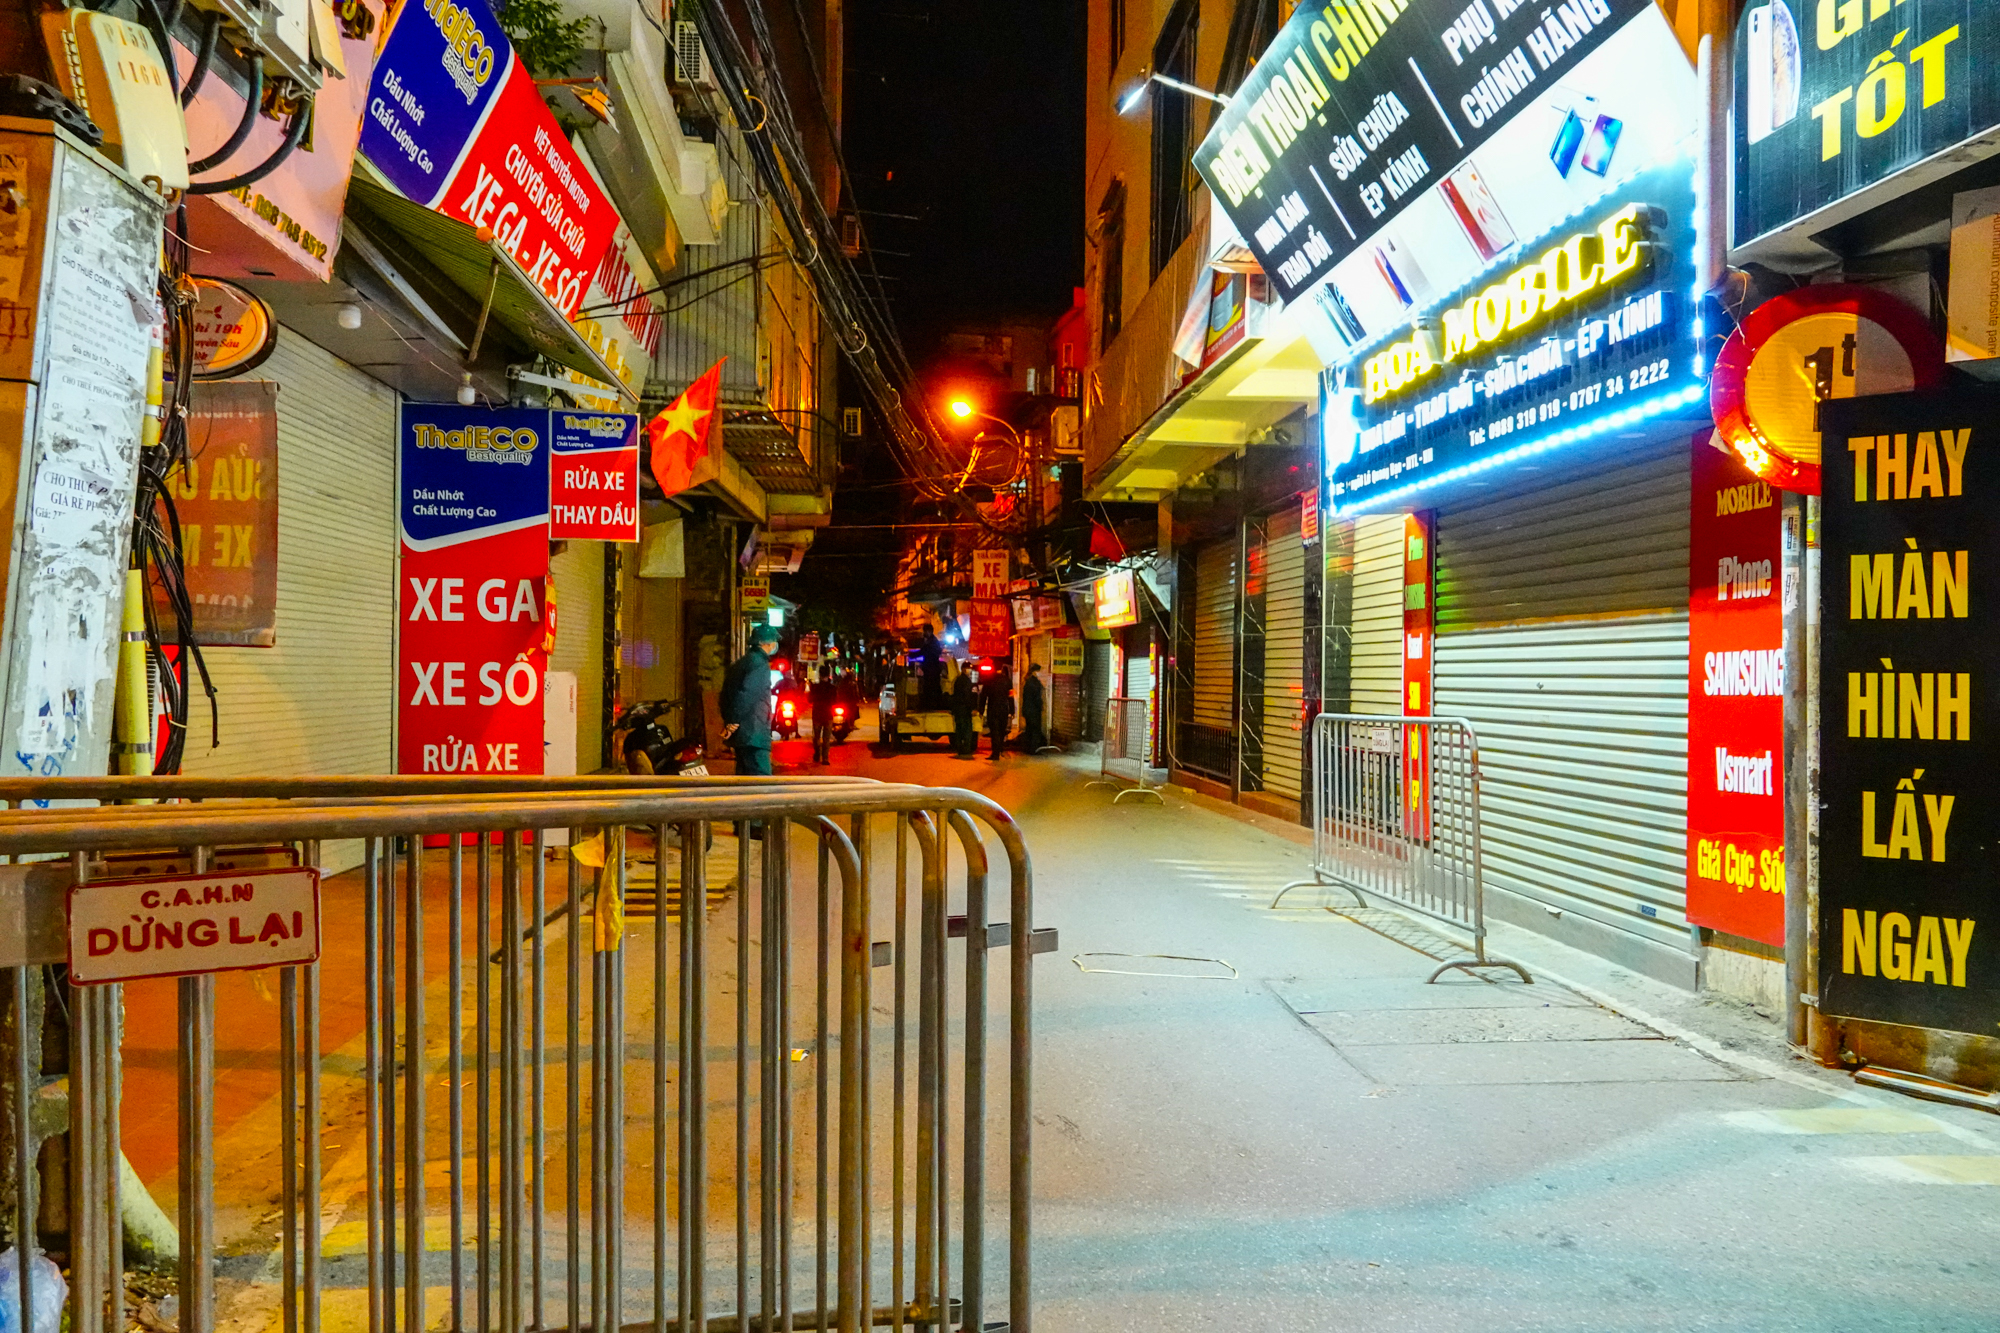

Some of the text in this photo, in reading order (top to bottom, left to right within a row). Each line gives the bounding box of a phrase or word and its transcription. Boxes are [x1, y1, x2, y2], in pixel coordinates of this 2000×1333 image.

[423, 0, 494, 87] haiECO
[1460, 0, 1611, 129] CHÍNH HÃNG
[382, 68, 425, 126] Dầu Nhớt
[1247, 60, 1330, 158] THOẠI
[1812, 24, 1960, 163] TỐT
[370, 97, 434, 175] Chất Lượng Cao
[1329, 90, 1410, 180] SỬA CHỮA
[505, 143, 586, 260] CHUYÊN SỬA CHỮA
[568, 177, 591, 215] MOTOR
[1359, 144, 1430, 219] ÉP KÍNH
[1275, 190, 1309, 233] BÁN
[61, 255, 76, 269] CHO
[460, 163, 504, 228] XE
[493, 201, 528, 259] GA
[528, 239, 561, 293] XE
[549, 267, 589, 317] SỐ
[1277, 250, 1312, 289] TRAO
[1442, 202, 1640, 363] MOBILE
[1578, 318, 1602, 358] ÉP
[1608, 290, 1662, 345] KÍNH
[62, 375, 76, 386] CHO
[1606, 375, 1624, 398] 34
[1629, 358, 1670, 391] 2222
[412, 424, 539, 452] ThaiECO
[563, 415, 626, 432] ThaiECO
[564, 465, 625, 491] RỬA XE
[1848, 428, 1972, 503] THAY
[412, 504, 497, 519] Chất Lượng Cao
[413, 487, 464, 501] Dầu Nhớt
[553, 501, 635, 526] THAY DẦU
[982, 562, 1002, 578] XE
[1718, 556, 1772, 601] iPhone
[1849, 537, 1970, 621] MÀN
[408, 576, 464, 623] XE
[476, 578, 541, 623] GA
[409, 647, 538, 707] XE SỐ
[1704, 648, 1784, 697] SAMSUNG
[1847, 657, 1971, 741] HÌNH
[423, 735, 519, 773] RỬA XE
[1715, 746, 1774, 797] Vsmart
[1861, 768, 1956, 864] LẤY
[1697, 838, 1722, 882] Giá
[1724, 843, 1755, 894] Cực
[140, 882, 254, 909] C.A.H.N
[88, 910, 303, 957] DỪNG LẠI
[1841, 908, 1976, 989] NGAY
